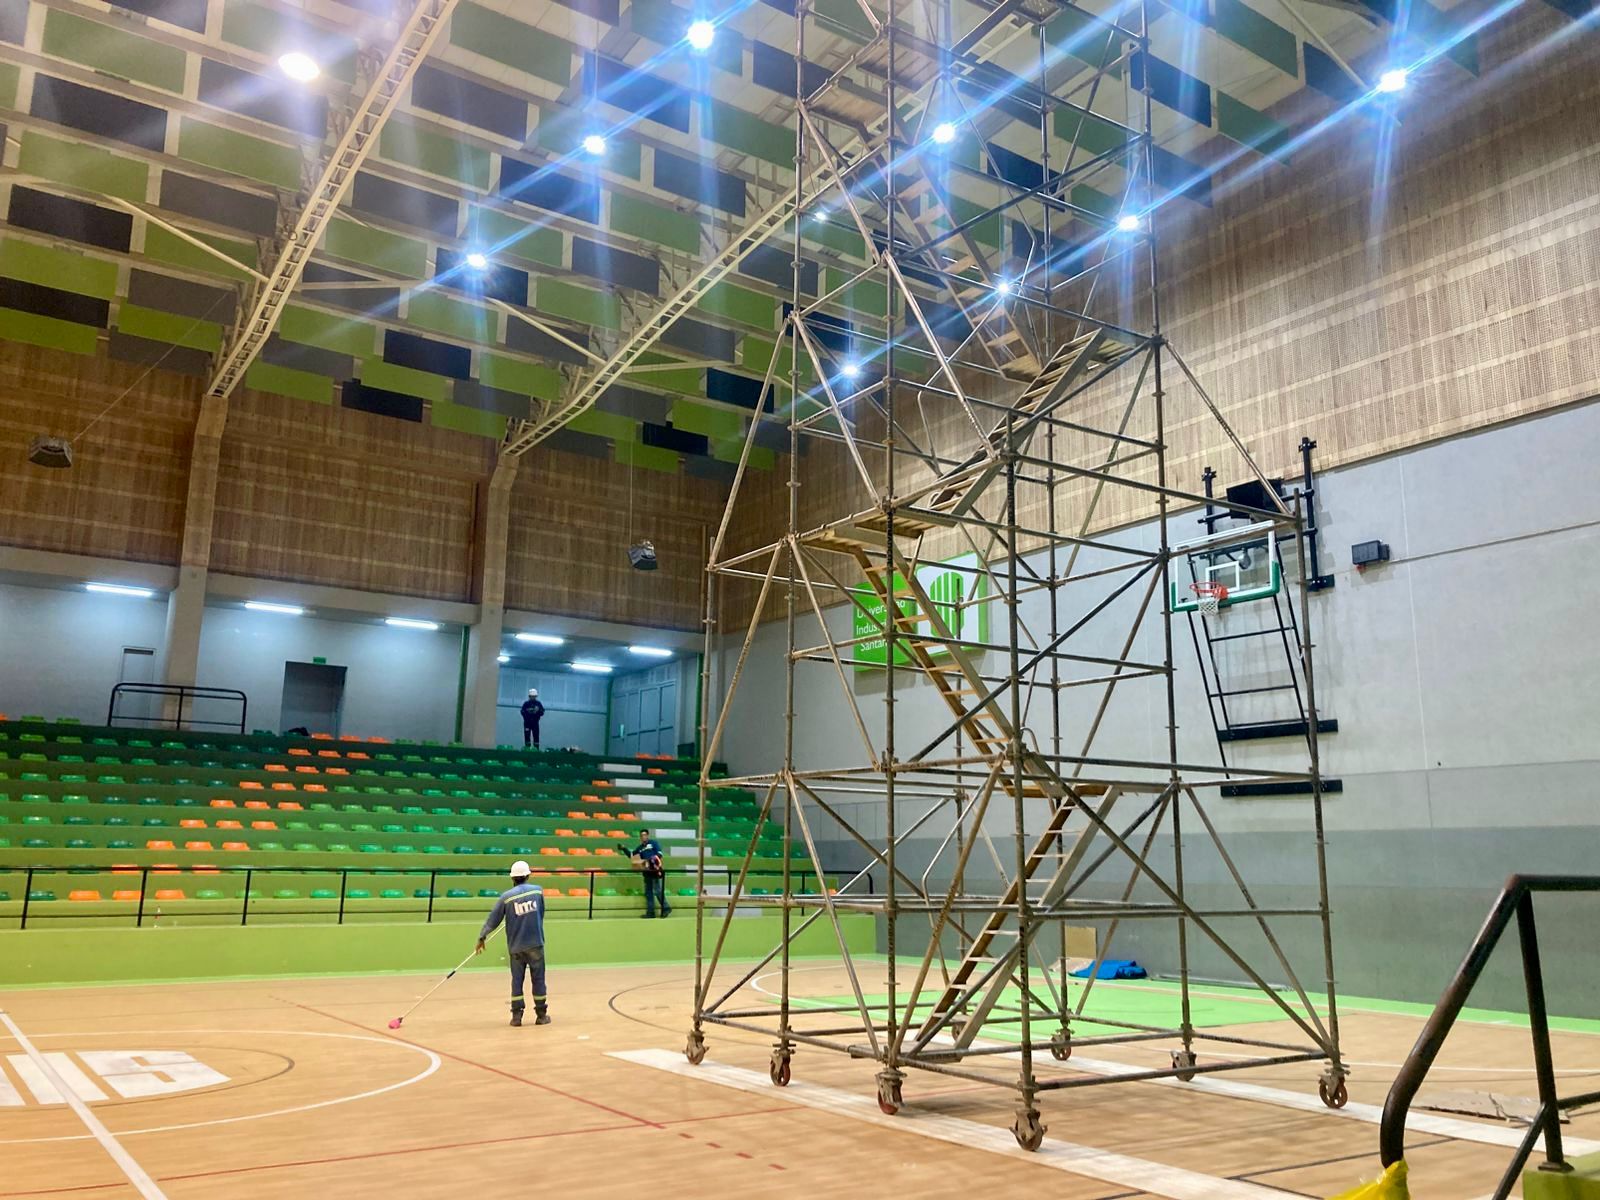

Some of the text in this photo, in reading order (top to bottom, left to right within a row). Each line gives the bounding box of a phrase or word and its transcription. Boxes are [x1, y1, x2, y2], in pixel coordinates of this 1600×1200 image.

[856, 599, 906, 619] Uiverad
[856, 620, 887, 636] Indus
[0, 1050, 232, 1107] IS
